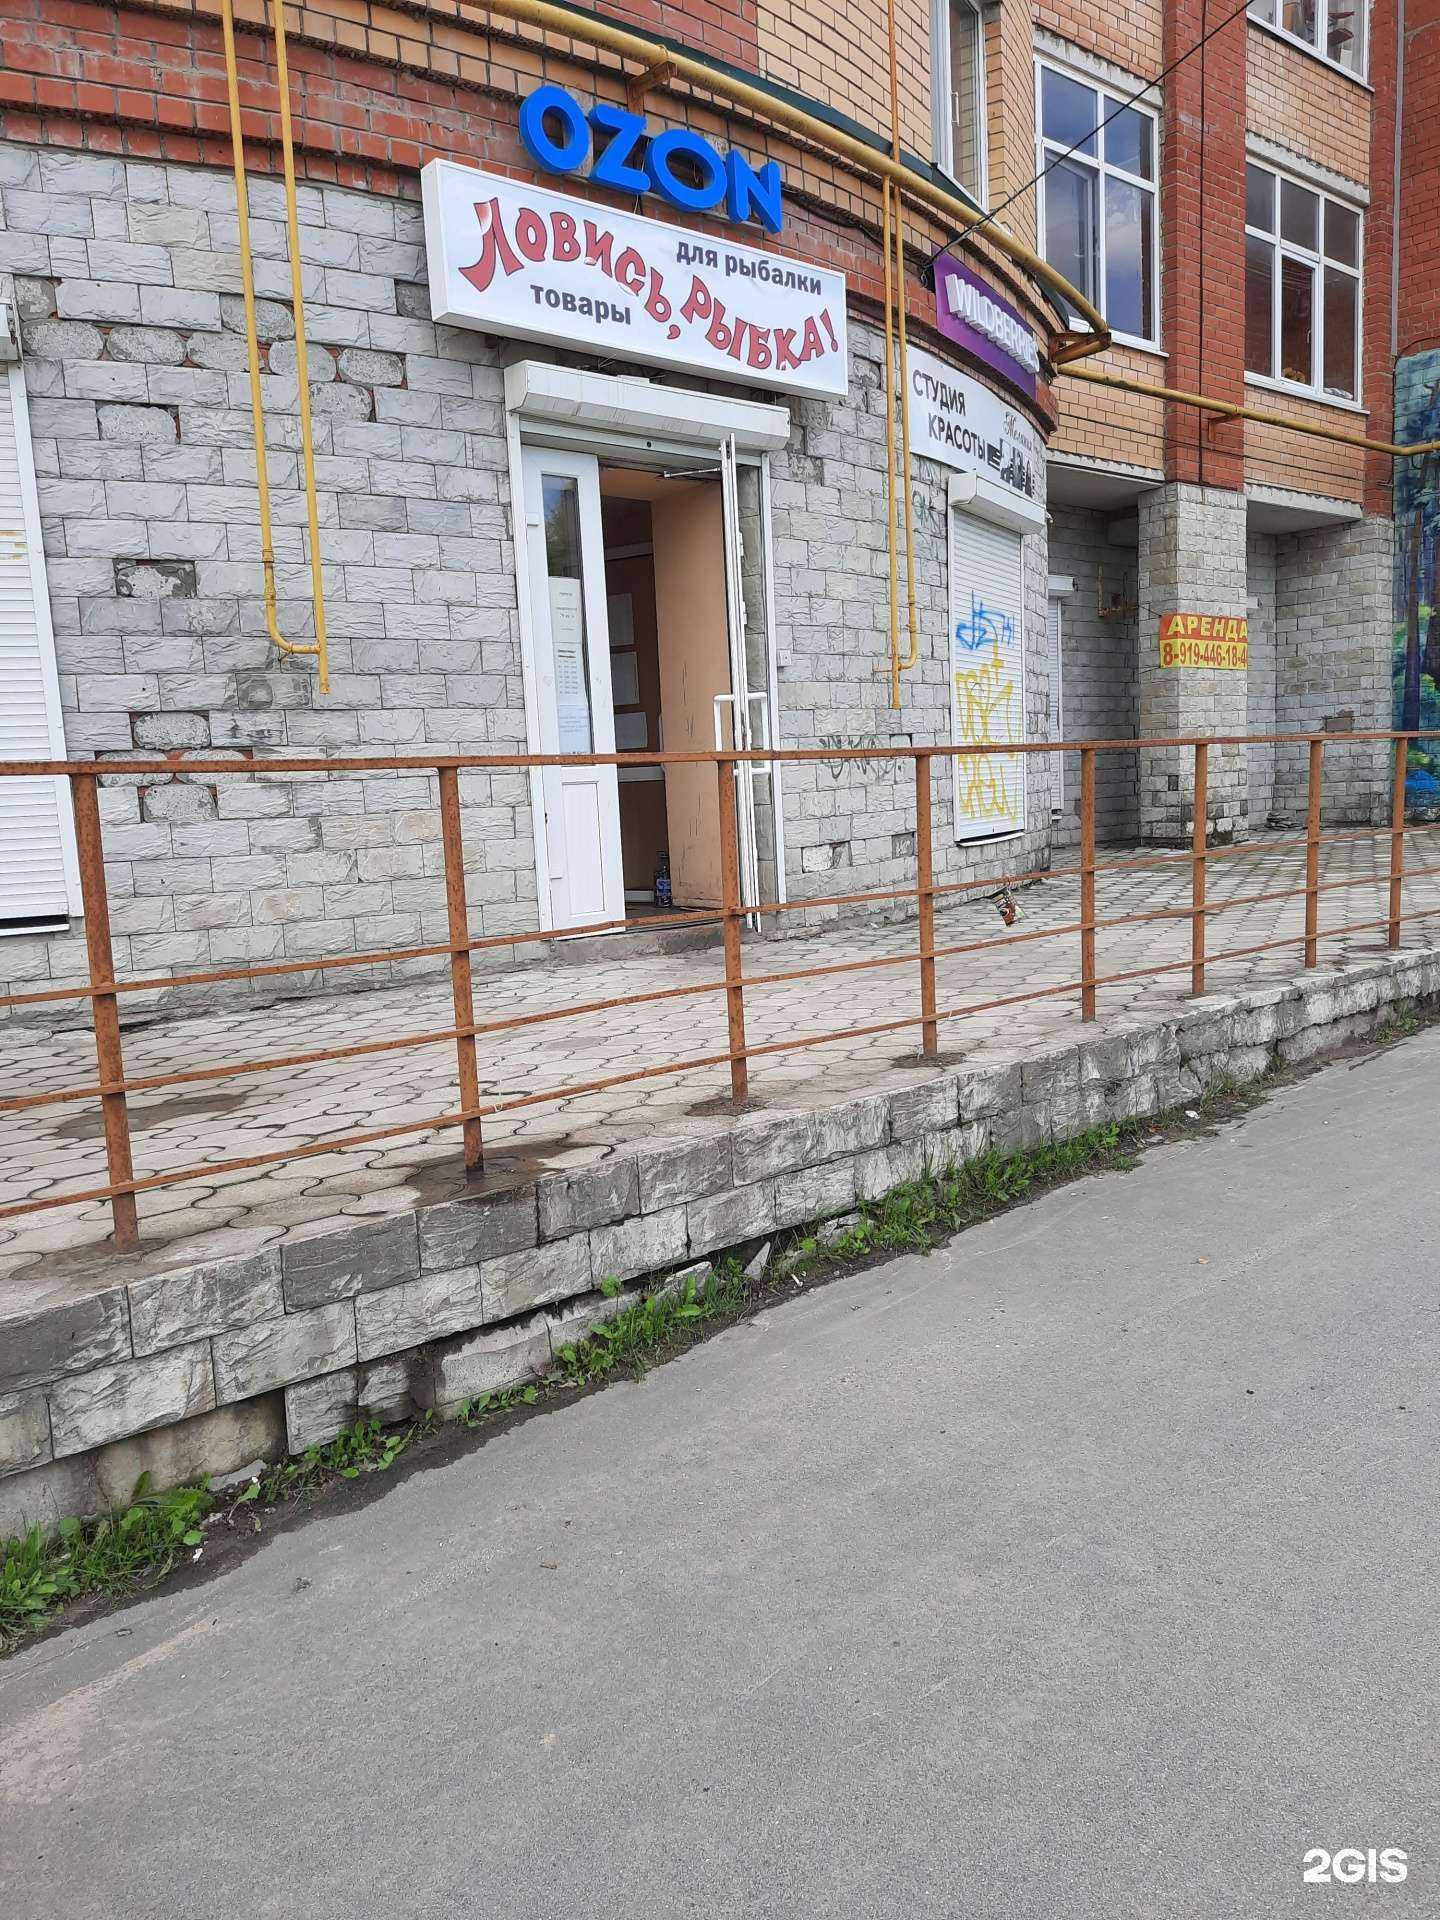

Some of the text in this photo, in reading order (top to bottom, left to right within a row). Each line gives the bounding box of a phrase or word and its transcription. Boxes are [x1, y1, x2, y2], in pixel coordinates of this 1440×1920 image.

[519, 85, 782, 234] OZON
[676, 240, 823, 296] для рыбалки
[530, 284, 632, 326] товары
[680, 274, 839, 371] РЫБКА!
[912, 369, 966, 416] СТУДИЯ
[928, 412, 986, 462] КРАСОТЫ
[1167, 615, 1248, 642] АРЕНДА
[1163, 642, 1248, 668] 8-919-446-18-4
